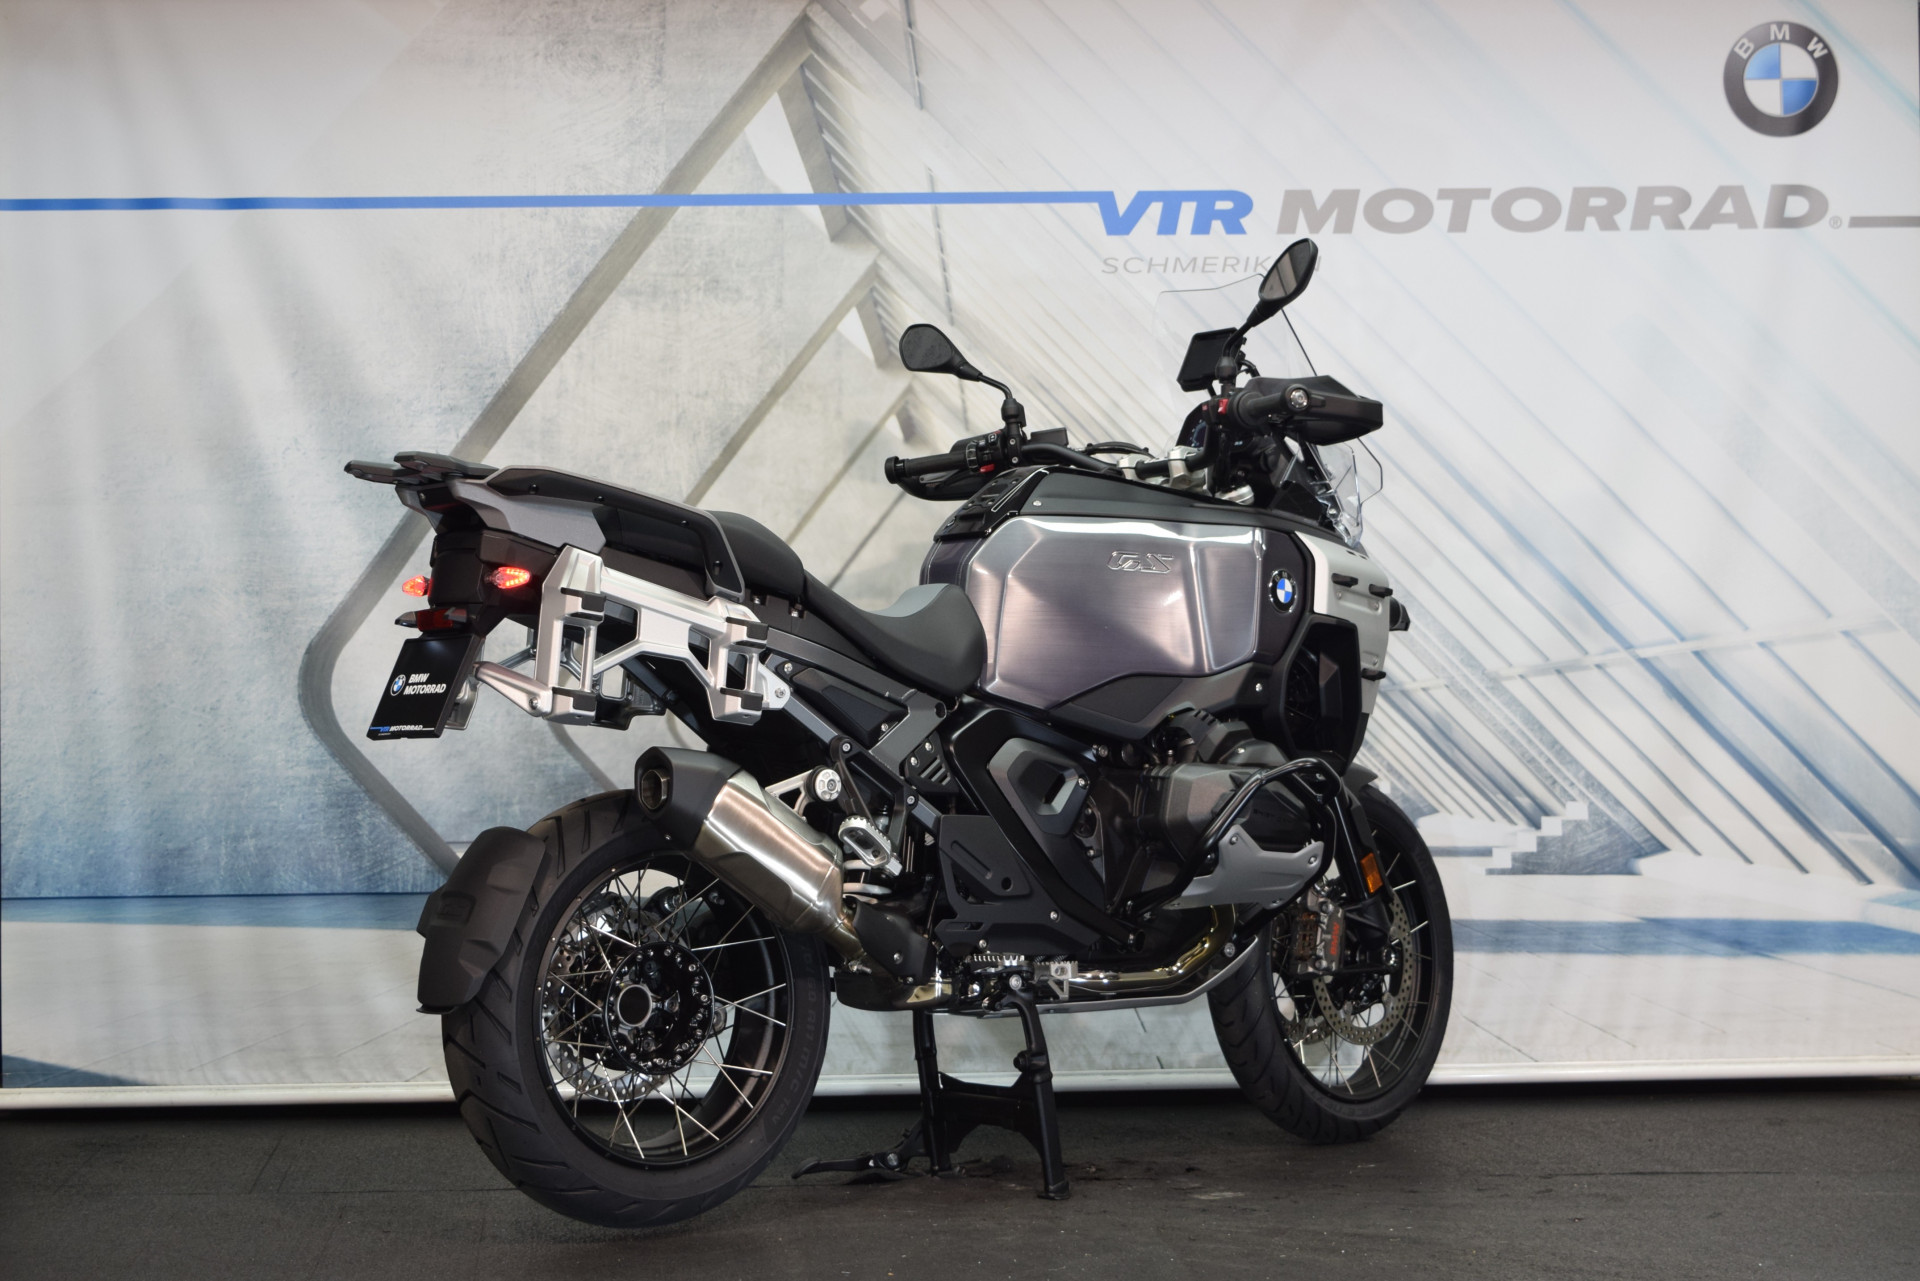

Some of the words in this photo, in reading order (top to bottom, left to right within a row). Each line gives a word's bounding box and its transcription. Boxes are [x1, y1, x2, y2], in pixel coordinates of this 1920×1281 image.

[1733, 23, 1829, 60] BMW
[1099, 190, 1254, 236] VTR
[1276, 184, 1830, 235] MOTORRAD
[1101, 256, 1322, 274] SCHMERIK
[1107, 551, 1174, 574] GS
[409, 673, 430, 683] BMW
[403, 684, 447, 695] MOTORRAD
